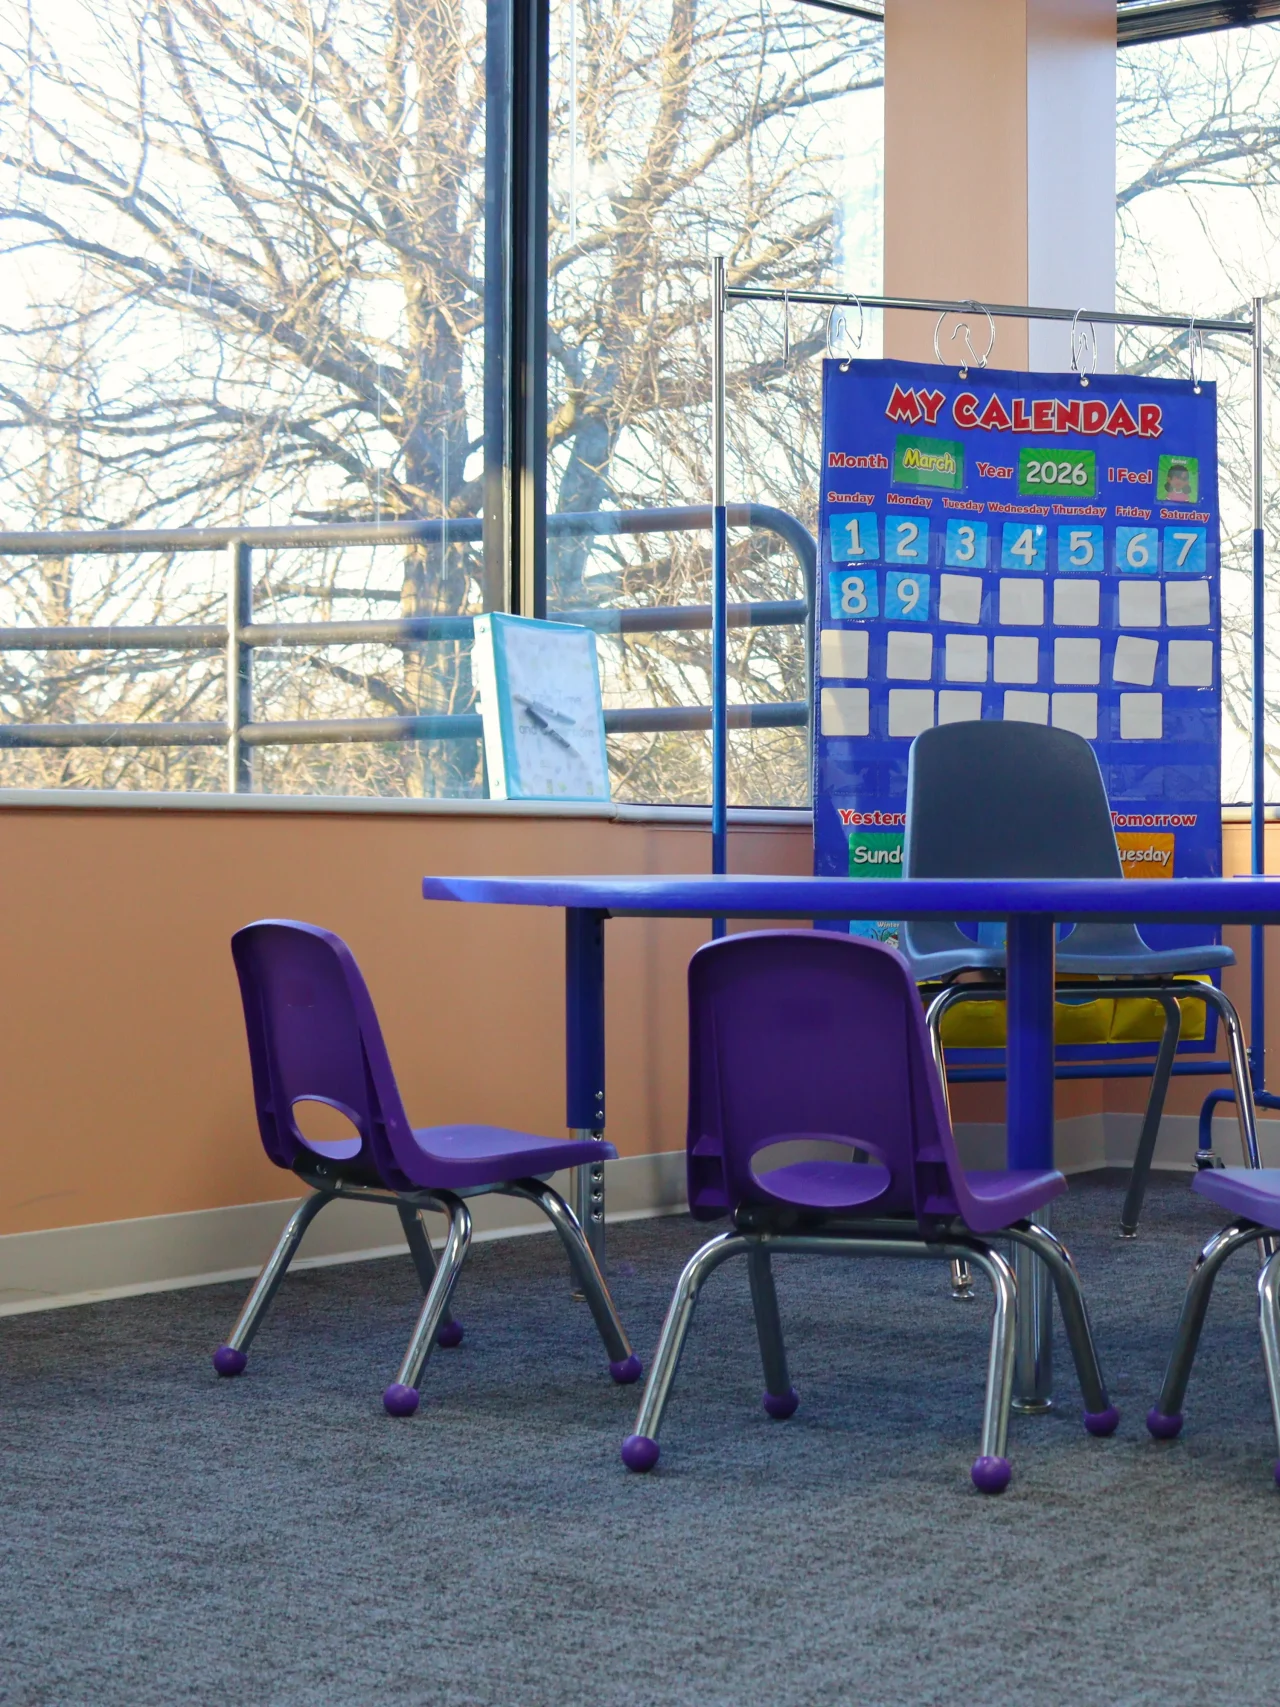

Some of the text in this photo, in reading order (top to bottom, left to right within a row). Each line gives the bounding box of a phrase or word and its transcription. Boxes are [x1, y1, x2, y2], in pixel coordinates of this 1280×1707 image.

[885, 383, 1164, 440] MY CALENDAR
[828, 452, 888, 469] Month
[903, 448, 956, 474] March
[976, 461, 1014, 479] Year
[1026, 461, 1088, 486] 2026
[1108, 468, 1153, 484] I Feel
[827, 491, 1210, 523] Sunday Monday Tuesday Wednesday Thursday Friday Saturday
[845, 518, 1199, 568] 1 2 3 4 5 6 7
[840, 577, 920, 615] 8 9
[1117, 845, 1171, 867] uesday
